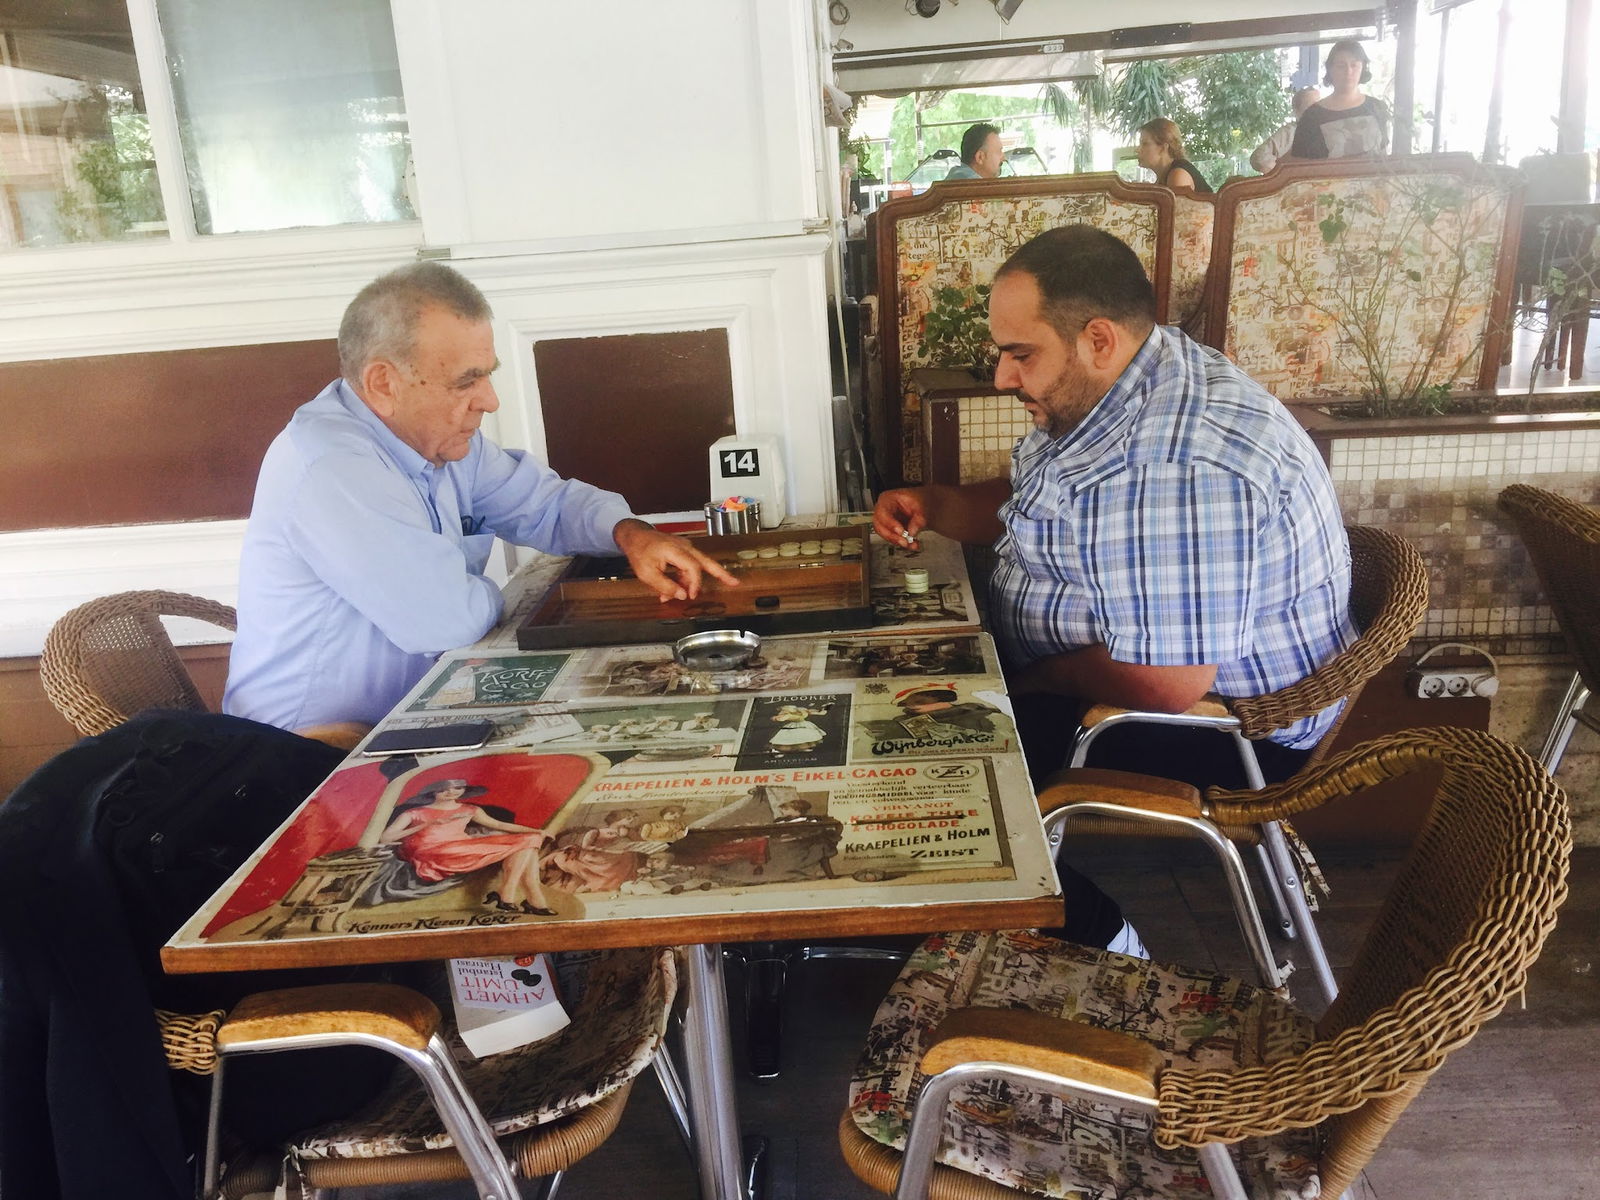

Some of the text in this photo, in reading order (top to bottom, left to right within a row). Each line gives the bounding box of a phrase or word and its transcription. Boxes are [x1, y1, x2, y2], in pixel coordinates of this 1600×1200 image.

[724, 451, 756, 473] 14
[700, 777, 712, 786] &
[865, 820, 960, 832] CHOCOLADE
[845, 827, 990, 853] KRAEPELIEN & HOLM
[910, 847, 979, 859] ZEIST
[348, 920, 412, 934] Kenners
[464, 987, 545, 1004] AHMET
